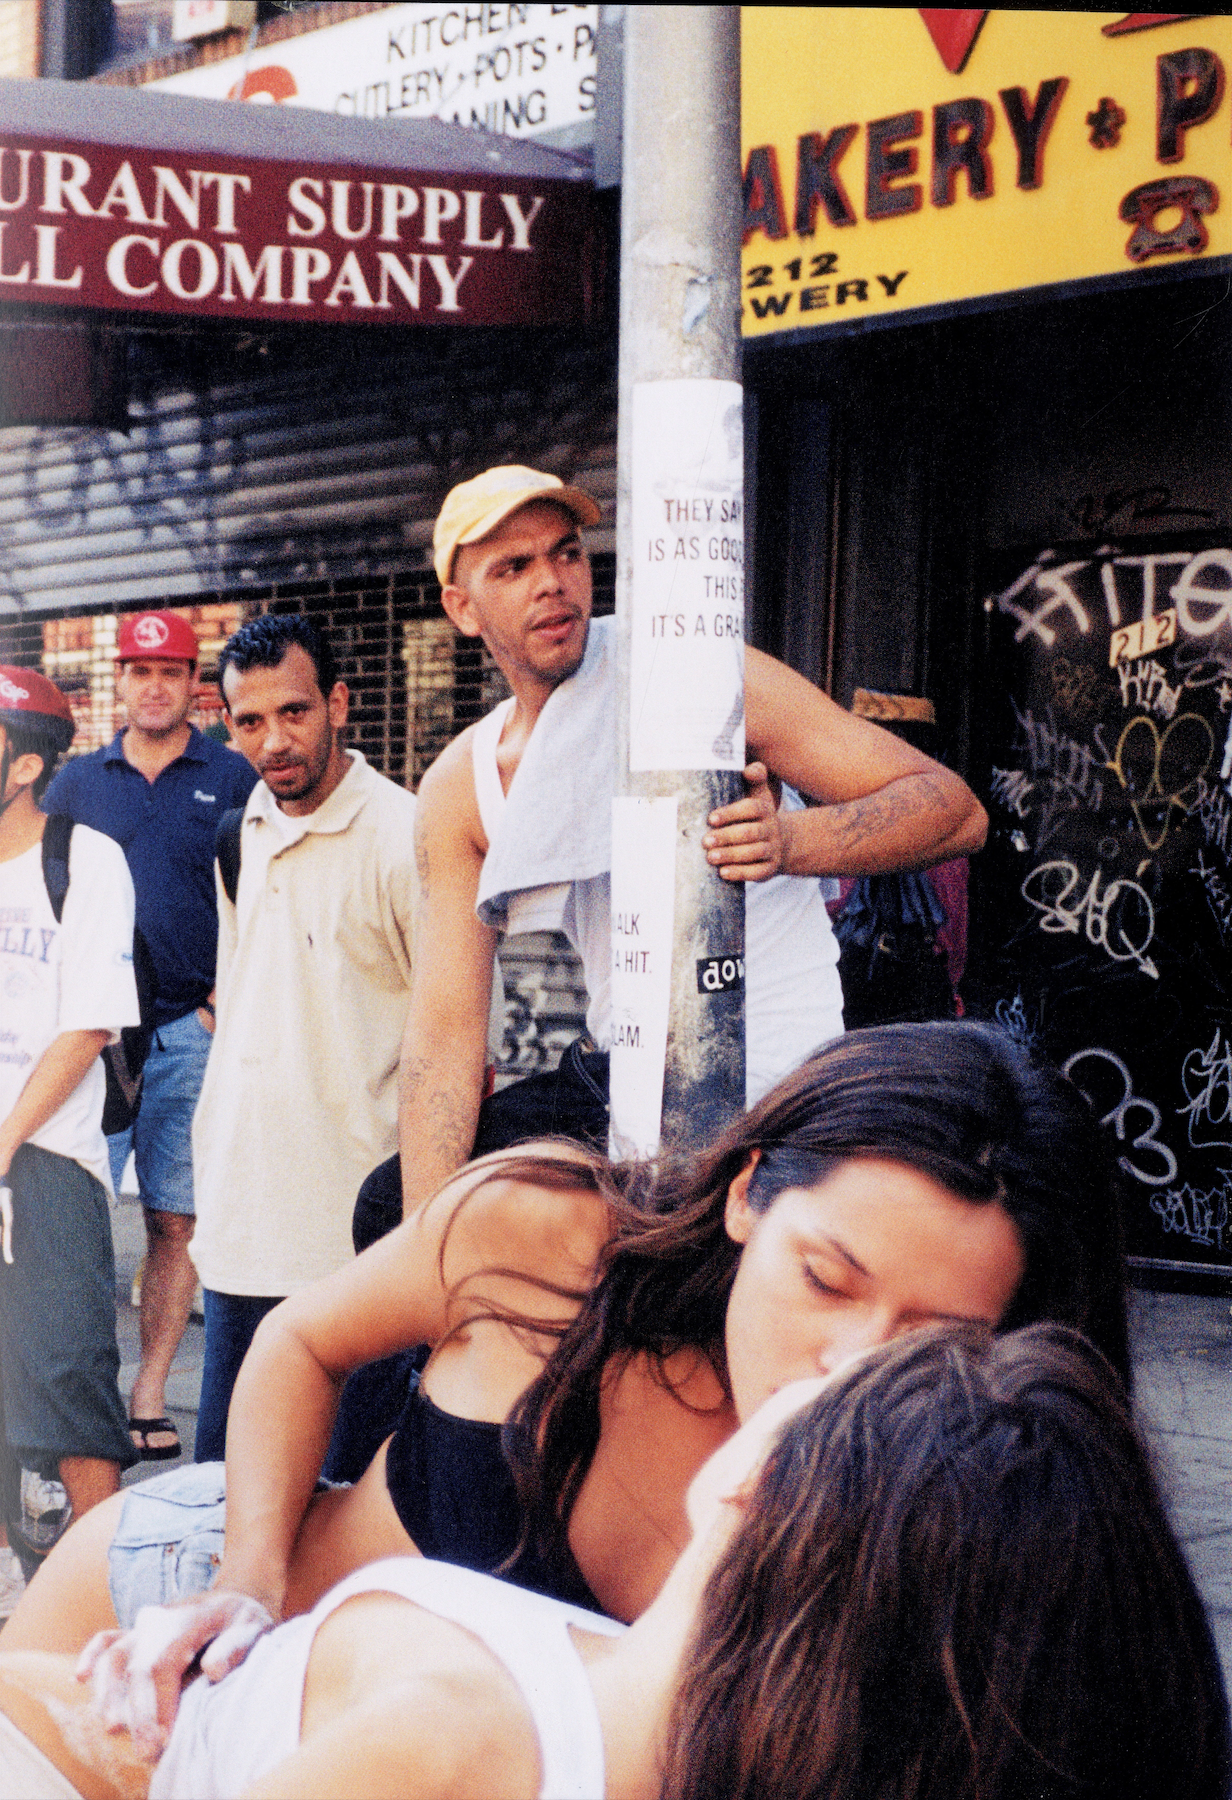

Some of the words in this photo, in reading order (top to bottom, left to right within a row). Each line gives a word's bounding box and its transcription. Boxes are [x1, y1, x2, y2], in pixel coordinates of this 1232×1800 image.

[387, 4, 527, 62] KITCHEN
[475, 37, 546, 87] POTS
[453, 89, 546, 134] NING
[1156, 46, 1232, 165] P
[741, 76, 1070, 248] AKERY
[287, 177, 544, 251] SUPPLY
[105, 233, 473, 312] COMPANY
[746, 251, 840, 289] 212
[750, 269, 909, 320] WERY
[664, 498, 714, 522] THEY
[648, 538, 665, 561] IS
[674, 536, 700, 560] AS
[703, 575, 738, 600] THIS
[694, 614, 706, 637] A
[611, 912, 640, 936] ALK
